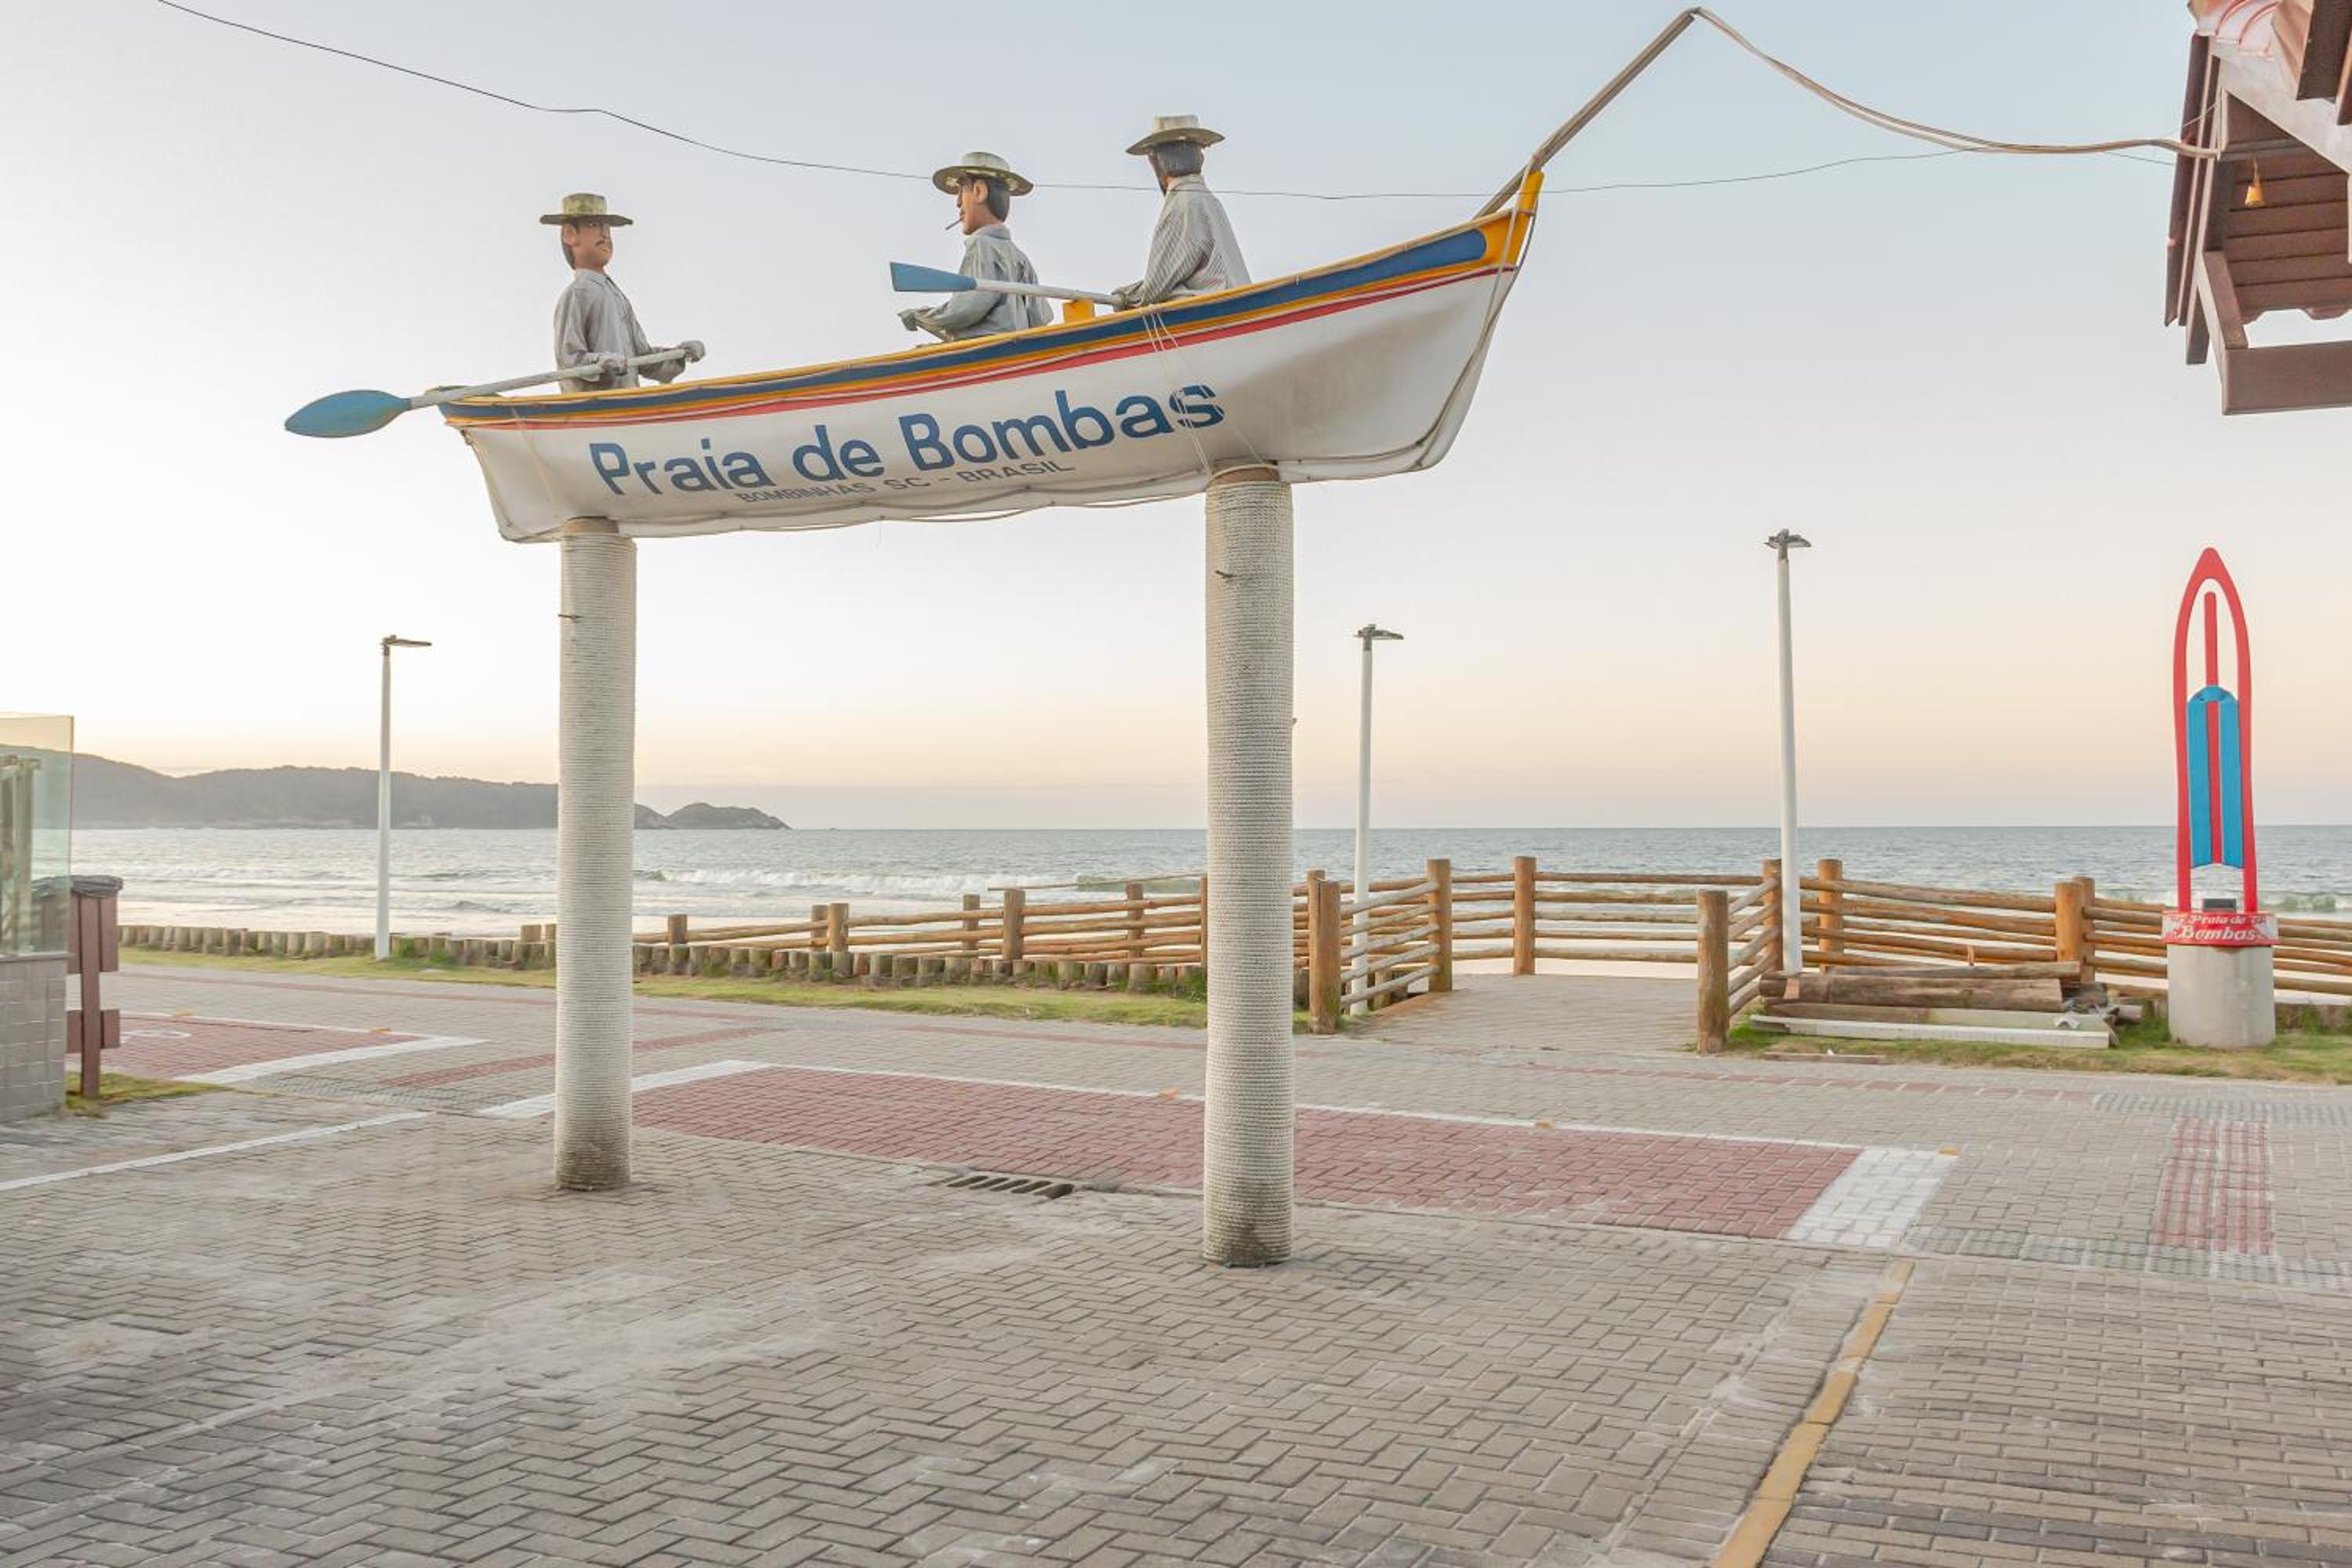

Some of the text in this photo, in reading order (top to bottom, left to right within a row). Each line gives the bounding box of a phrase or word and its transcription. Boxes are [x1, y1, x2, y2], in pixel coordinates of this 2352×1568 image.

[589, 384, 1225, 495] Praia de Bombas
[735, 481, 877, 503] BOMBINHAS
[883, 476, 931, 491] SC
[956, 459, 1076, 483] BRASIL
[2179, 924, 2258, 941] Bombas
